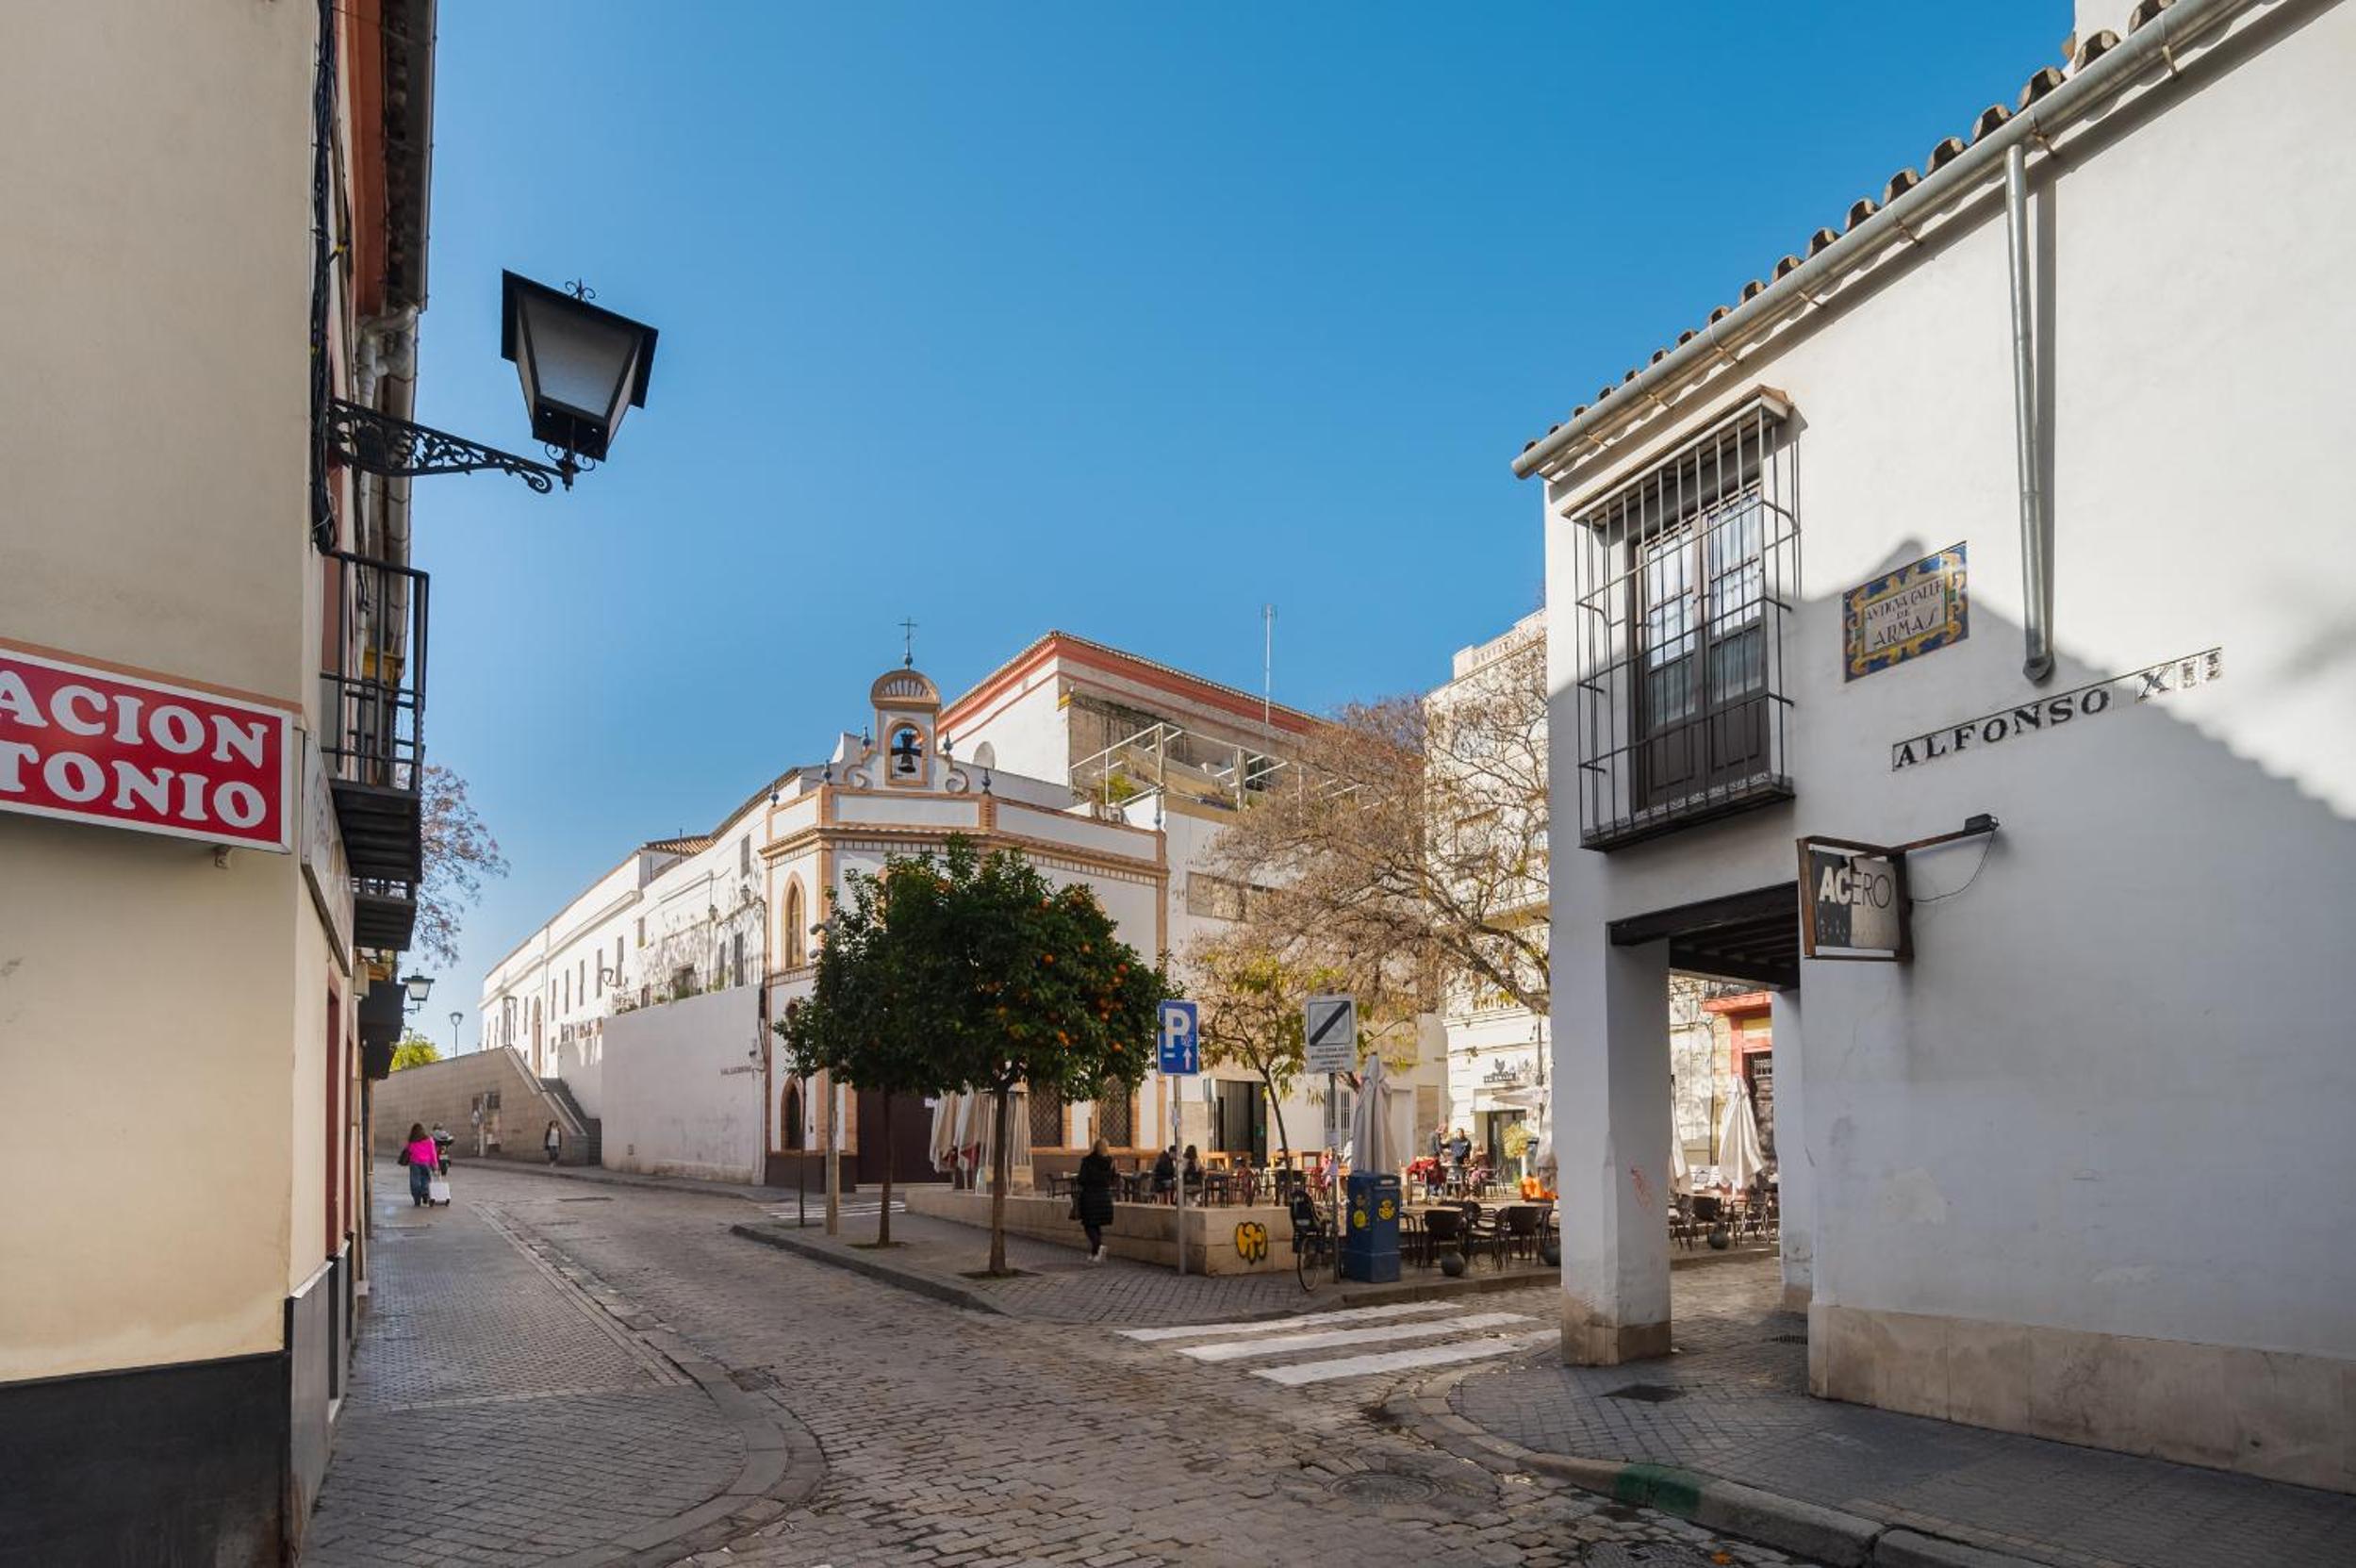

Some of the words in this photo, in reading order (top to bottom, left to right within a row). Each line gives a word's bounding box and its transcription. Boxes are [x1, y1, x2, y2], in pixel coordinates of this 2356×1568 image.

[1910, 579, 1942, 605] CALLE
[1873, 607, 1937, 645] ARMAS
[0, 670, 269, 769] ACION
[1895, 688, 2110, 767] ALFONSO
[2135, 650, 2223, 703] XII
[0, 741, 267, 829] TONIO
[1819, 866, 1892, 909] ACERO
[1165, 1008, 1192, 1049] P
